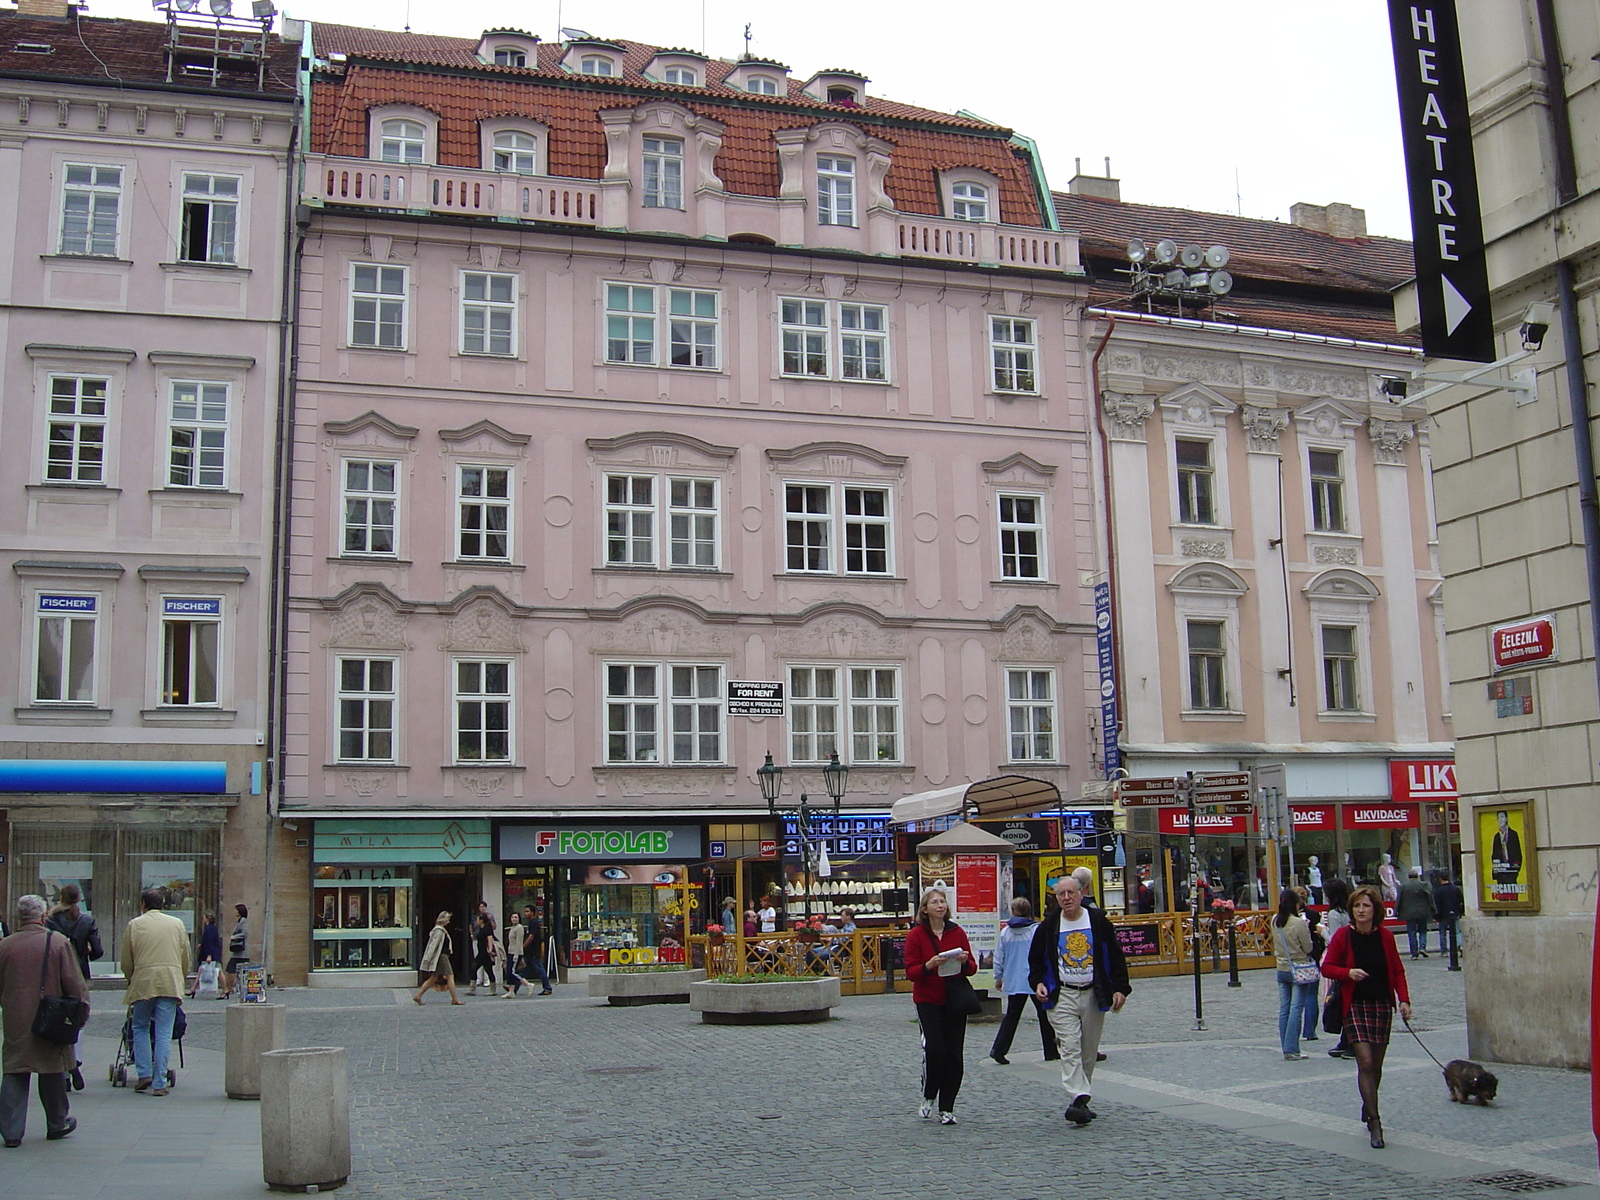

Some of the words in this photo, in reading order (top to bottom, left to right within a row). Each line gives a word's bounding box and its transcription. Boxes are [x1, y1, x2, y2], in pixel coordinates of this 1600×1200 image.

[42, 598, 88, 608] FISCHER
[166, 602, 212, 611] FISCHER
[1501, 626, 1539, 649] ŽELEZNÁ
[755, 700, 783, 708] PRONÁJMU
[1354, 809, 1408, 820] LIKVIDACE
[1005, 821, 1025, 829] CAFÉ
[340, 836, 392, 846] MILA
[559, 830, 669, 854] FOTOLAB
[1066, 857, 1084, 865] ooden
[339, 868, 392, 880] MILA
[523, 879, 544, 887] FOTO
[571, 949, 609, 965] DIGI
[609, 948, 654, 965] FOTO
